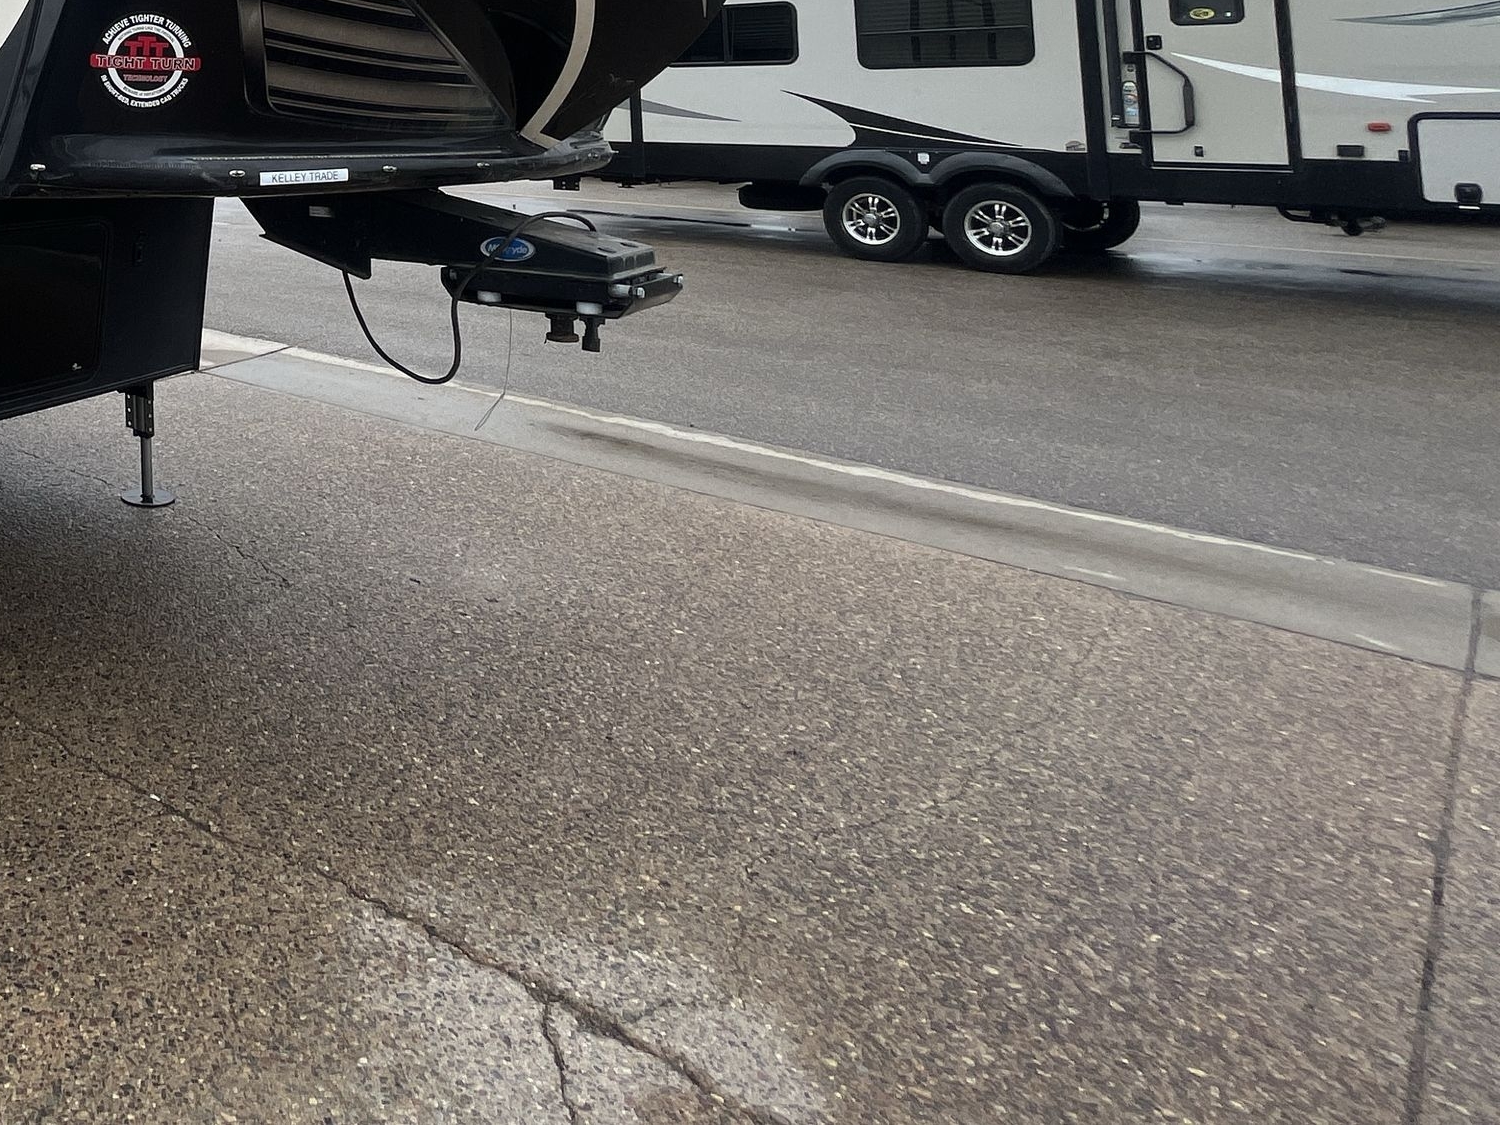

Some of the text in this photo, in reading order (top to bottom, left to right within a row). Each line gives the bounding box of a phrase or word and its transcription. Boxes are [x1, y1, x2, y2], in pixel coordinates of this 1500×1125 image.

[102, 14, 192, 48] ACHIEVE TIGHTER TURNING
[124, 36, 169, 56] TTT
[95, 54, 196, 71] TIGHT TURN
[123, 74, 168, 82] TECHNOLOGY
[130, 99, 160, 108] EXTENDED
[160, 94, 173, 104] CAB
[172, 77, 189, 98] TRUCKS
[271, 171, 339, 184] KELLEY TRADE
[487, 243, 529, 255] Myde
